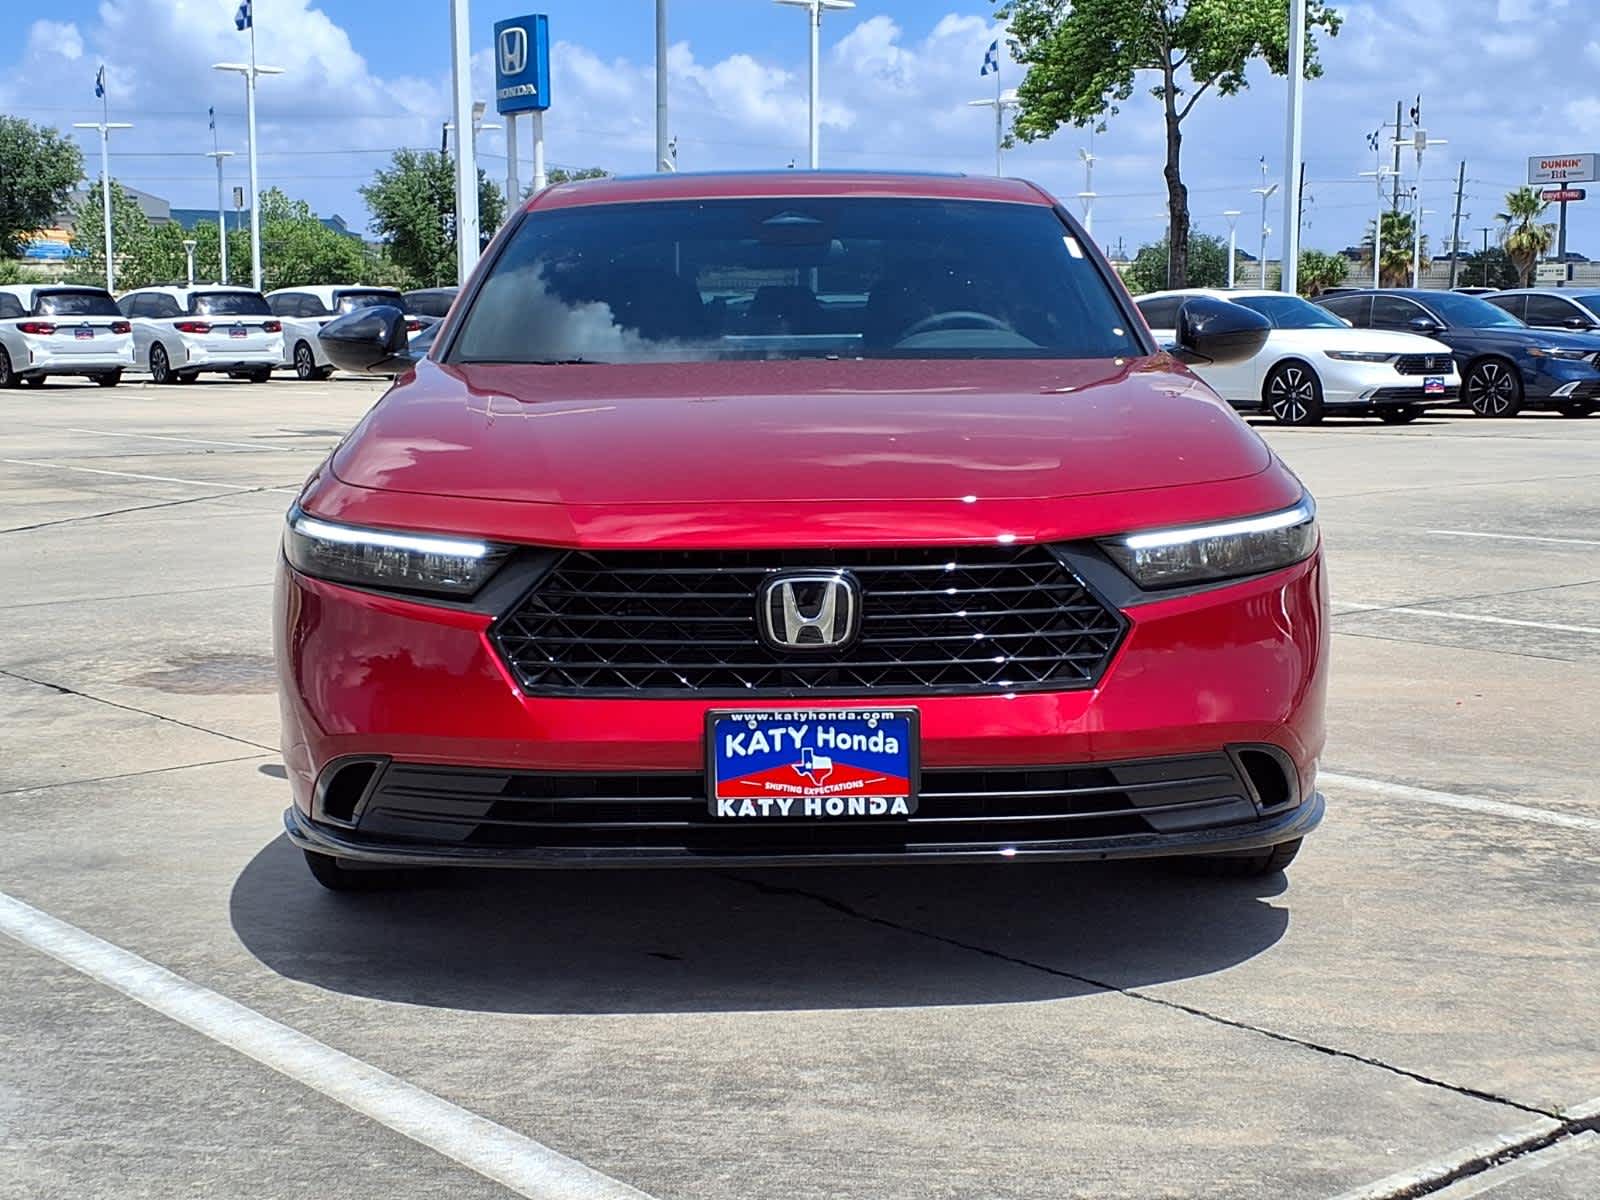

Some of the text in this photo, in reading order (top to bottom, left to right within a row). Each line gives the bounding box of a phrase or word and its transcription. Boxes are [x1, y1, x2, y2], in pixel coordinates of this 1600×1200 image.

[731, 711, 895, 721] www.katyhonda.com
[726, 725, 899, 758] KATY Honda
[765, 780, 864, 795] SHIFTING EXPECTATIONS
[717, 798, 909, 816] KATY HONDA
